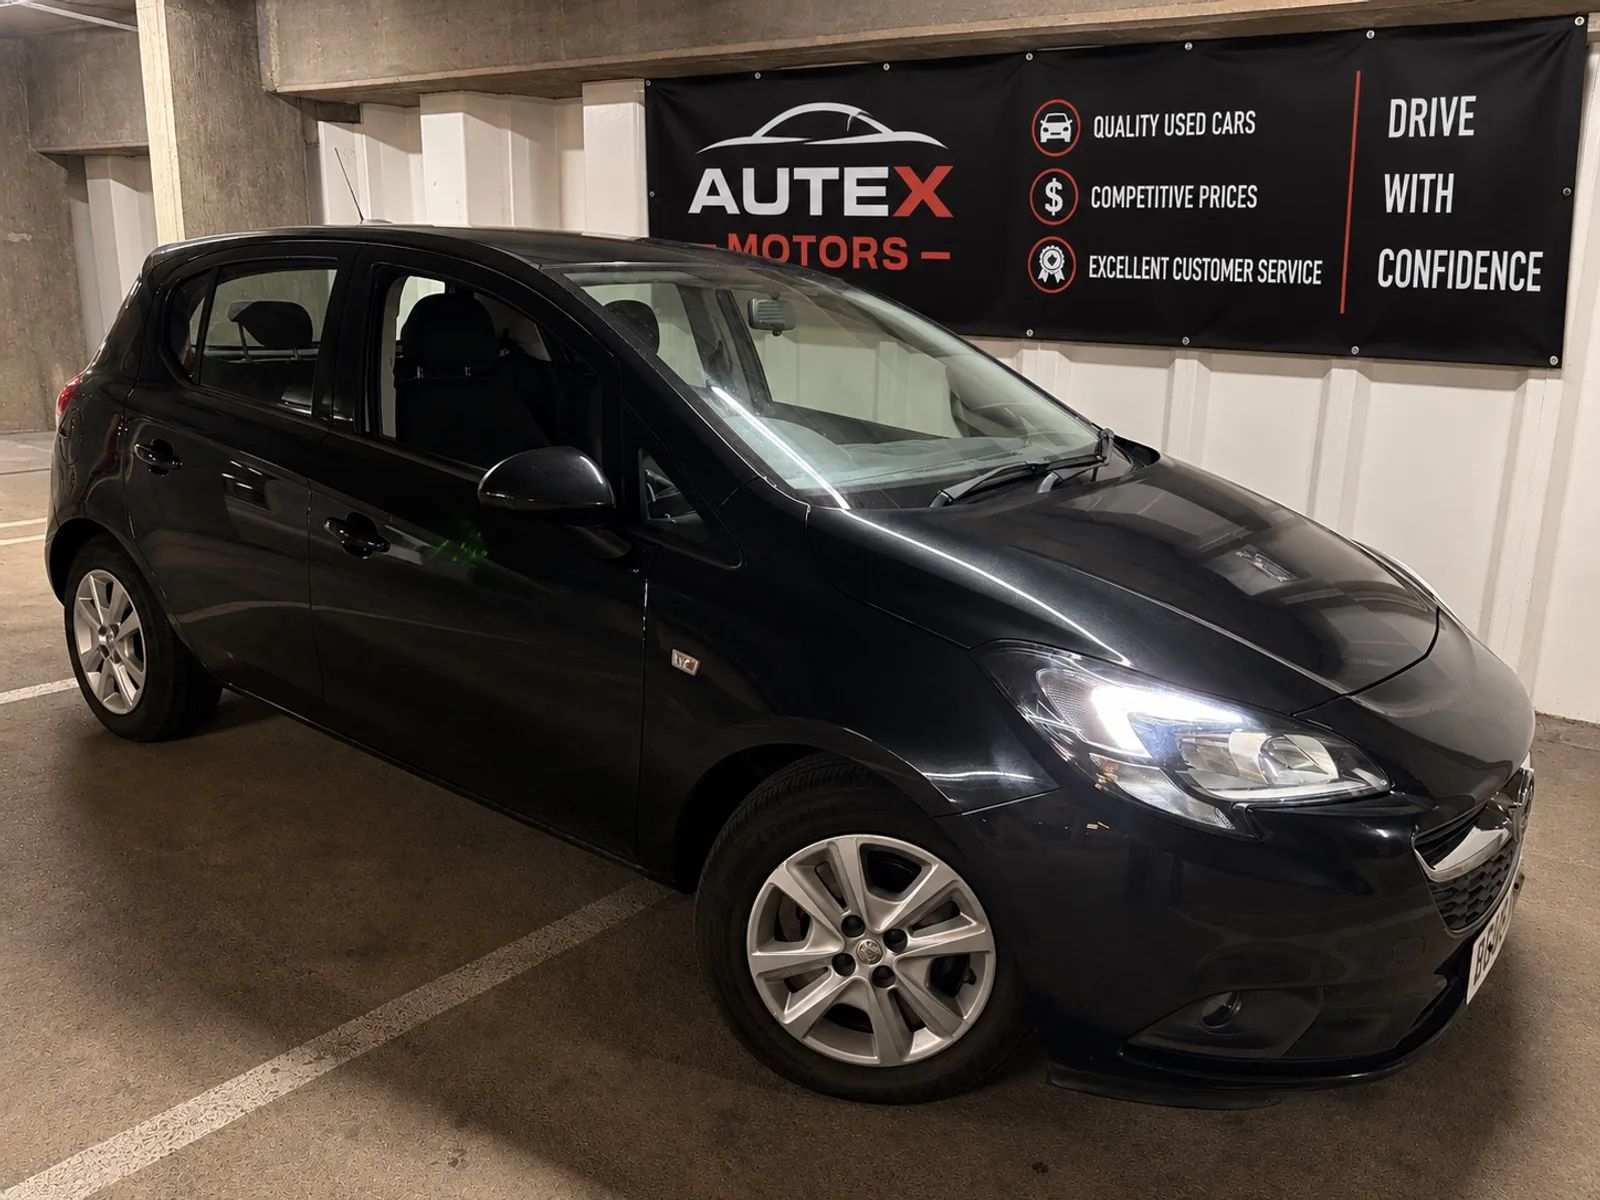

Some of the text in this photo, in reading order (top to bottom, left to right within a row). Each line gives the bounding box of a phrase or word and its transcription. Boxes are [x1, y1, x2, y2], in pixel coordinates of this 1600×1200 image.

[1093, 110, 1257, 139] QUALITY USED CARS
[1388, 95, 1477, 139] DRIVE
[687, 165, 954, 219] AUTEX
[1091, 184, 1258, 210] COMPETITIVE PRICES
[1384, 172, 1455, 214] WITH
[1088, 255, 1323, 285] EXCELLENT CUSTOMER SERVICE
[1377, 248, 1544, 293] CONFIDENCE
